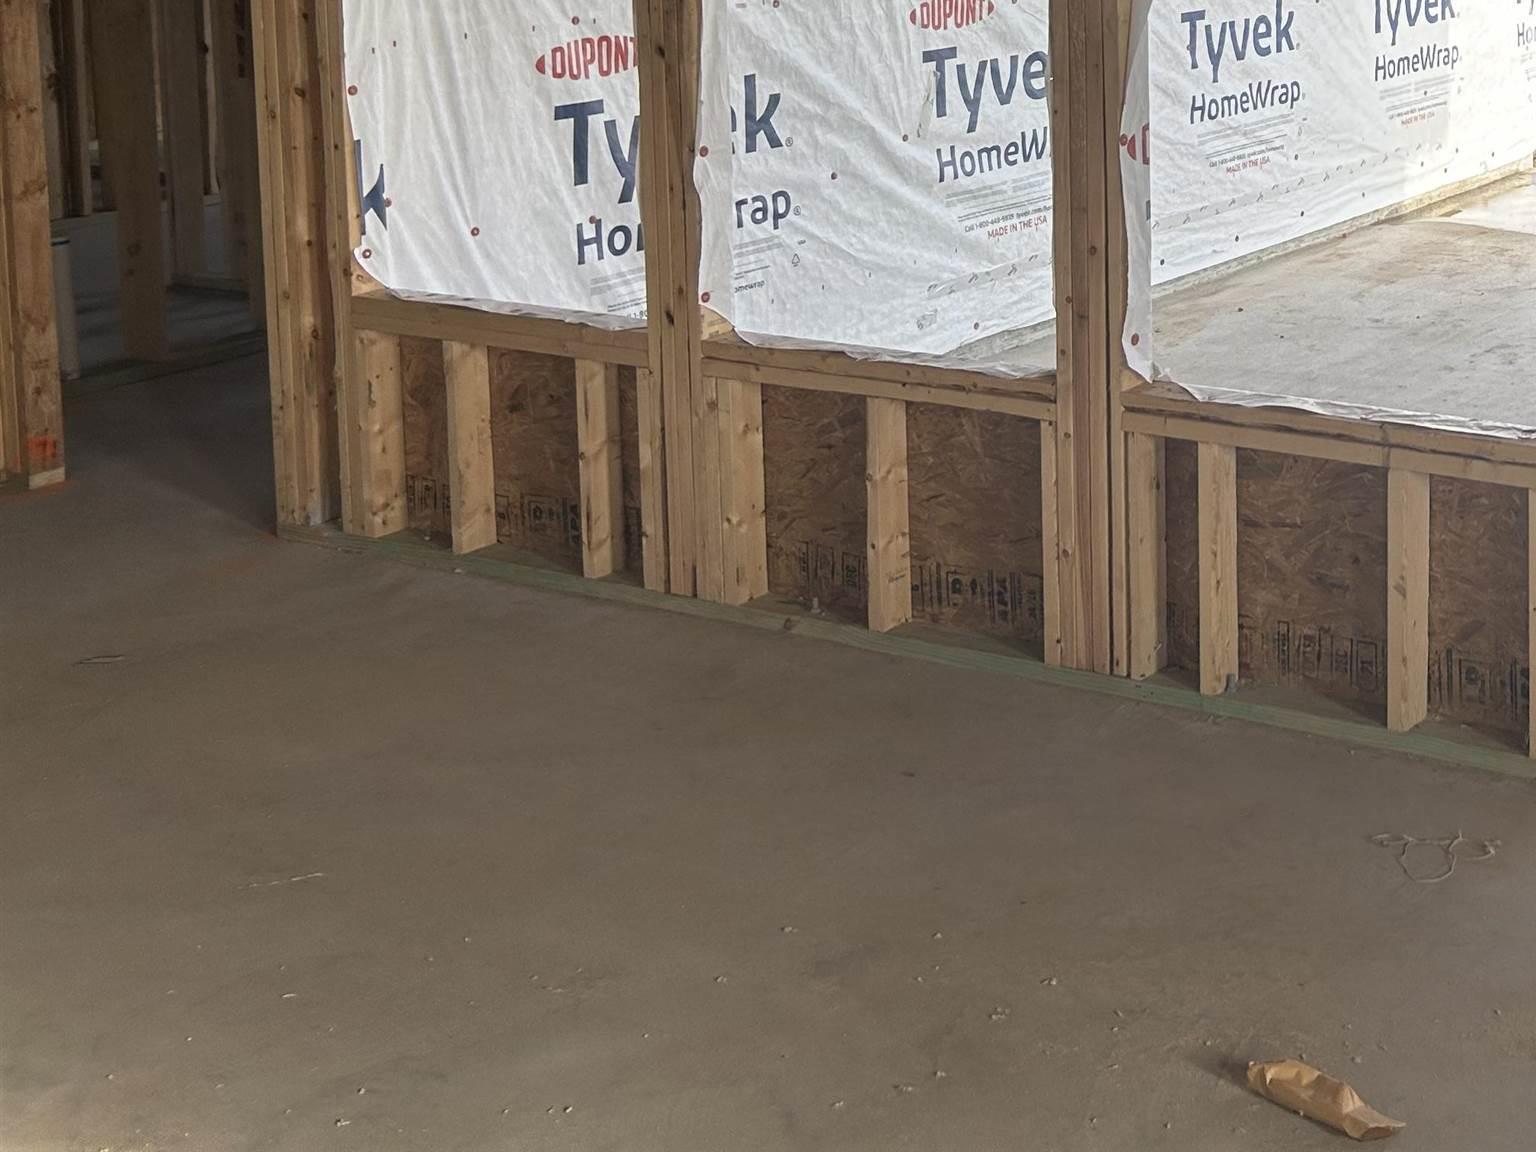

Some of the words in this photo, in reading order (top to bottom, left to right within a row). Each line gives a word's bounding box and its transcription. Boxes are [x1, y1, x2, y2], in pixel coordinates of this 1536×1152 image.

[1374, 43, 1460, 82] HomeWrap
[922, 45, 1048, 133] Tyve
[1190, 78, 1302, 125] HomeWrap
[735, 189, 792, 230] rap
[987, 226, 1009, 240] MADE
[1019, 218, 1033, 232] THE
[1033, 214, 1048, 227] USA
[576, 218, 646, 265] Ho
